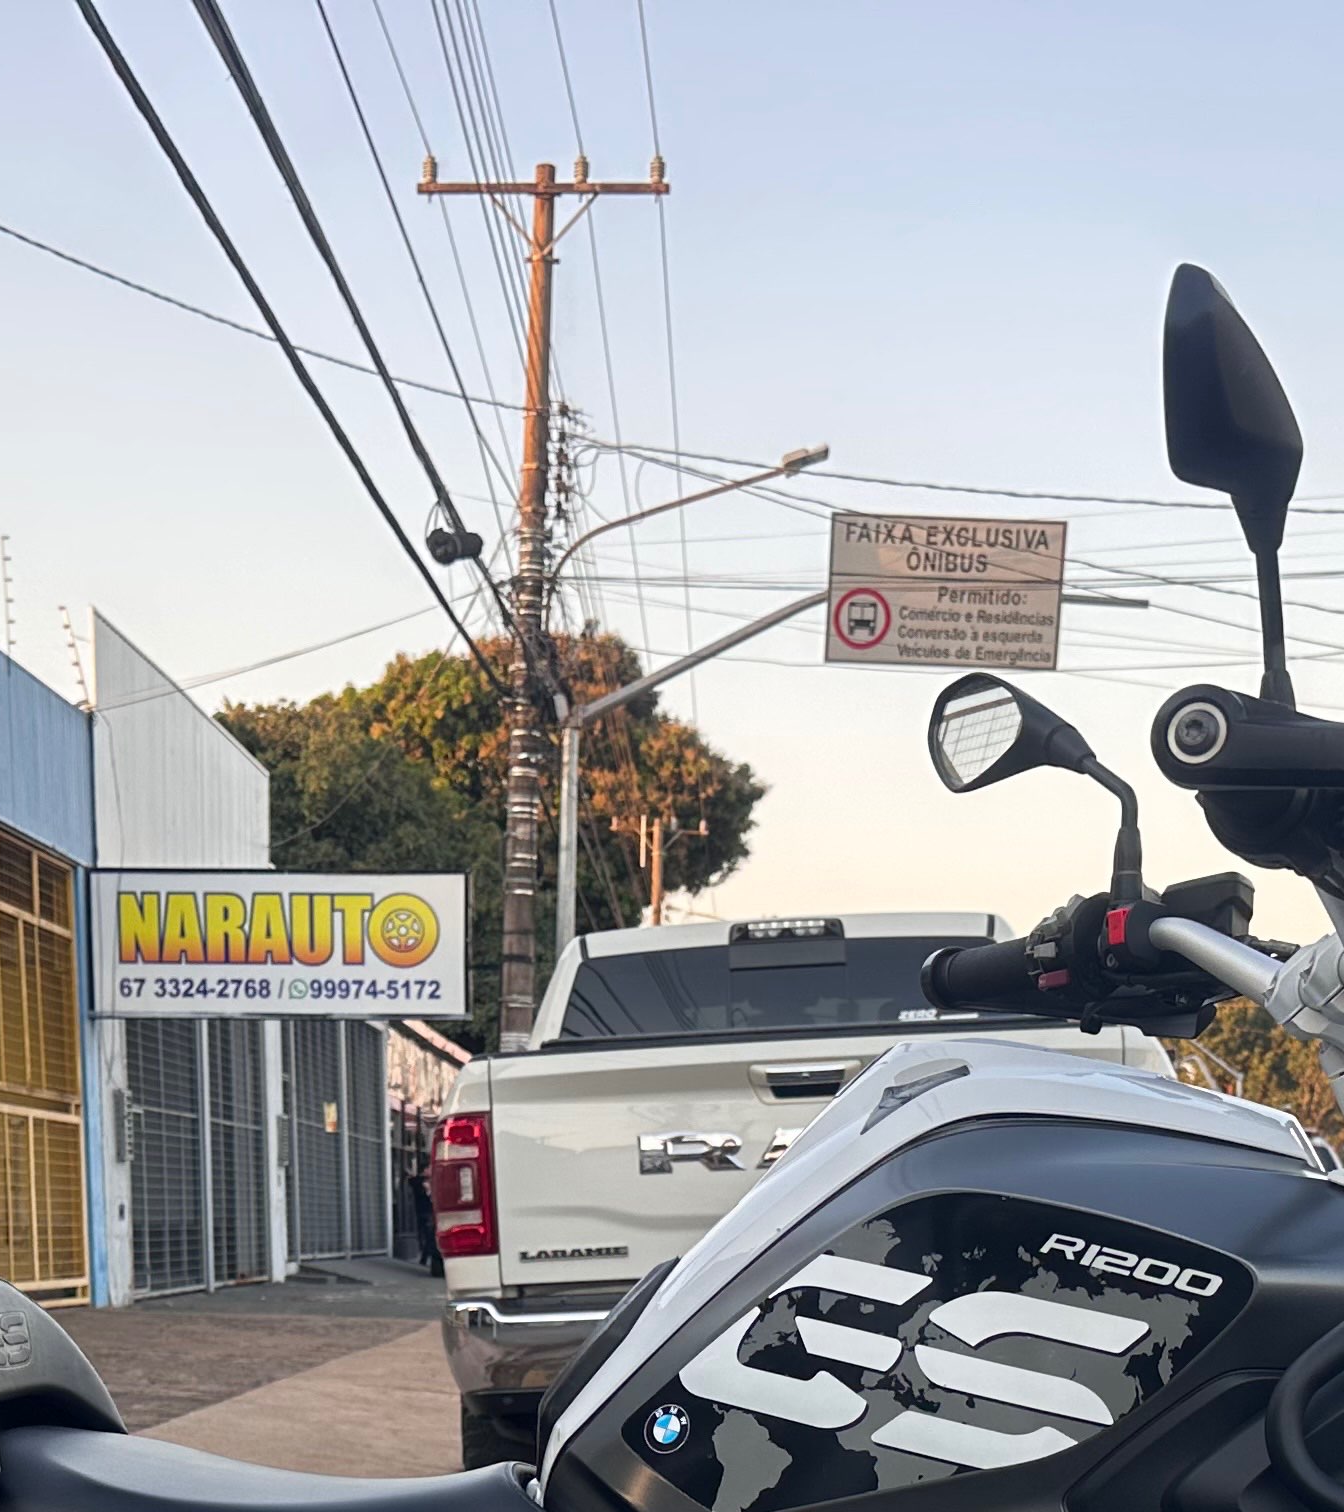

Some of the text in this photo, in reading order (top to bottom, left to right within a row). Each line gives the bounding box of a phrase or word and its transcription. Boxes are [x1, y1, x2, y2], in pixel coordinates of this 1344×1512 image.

[845, 522, 1049, 550] FAIXA EXCLUSIVA
[906, 547, 988, 573] ÔNIBUS
[937, 586, 1027, 606] Permitido:
[899, 607, 1054, 627] Comércio e Residências
[897, 625, 967, 641] Conversão
[983, 629, 1043, 647] esquerda
[896, 643, 1051, 665] Veículos de Emergência
[118, 891, 440, 968] NARAUTO
[119, 978, 145, 999] 67
[154, 978, 271, 1000] 3324-2768
[310, 979, 441, 1000] 99974-5172
[519, 1246, 629, 1263] LARAMIE
[1039, 1233, 1223, 1297] R1200
[679, 1253, 1151, 1470] GS
[655, 1406, 687, 1425] BMW
